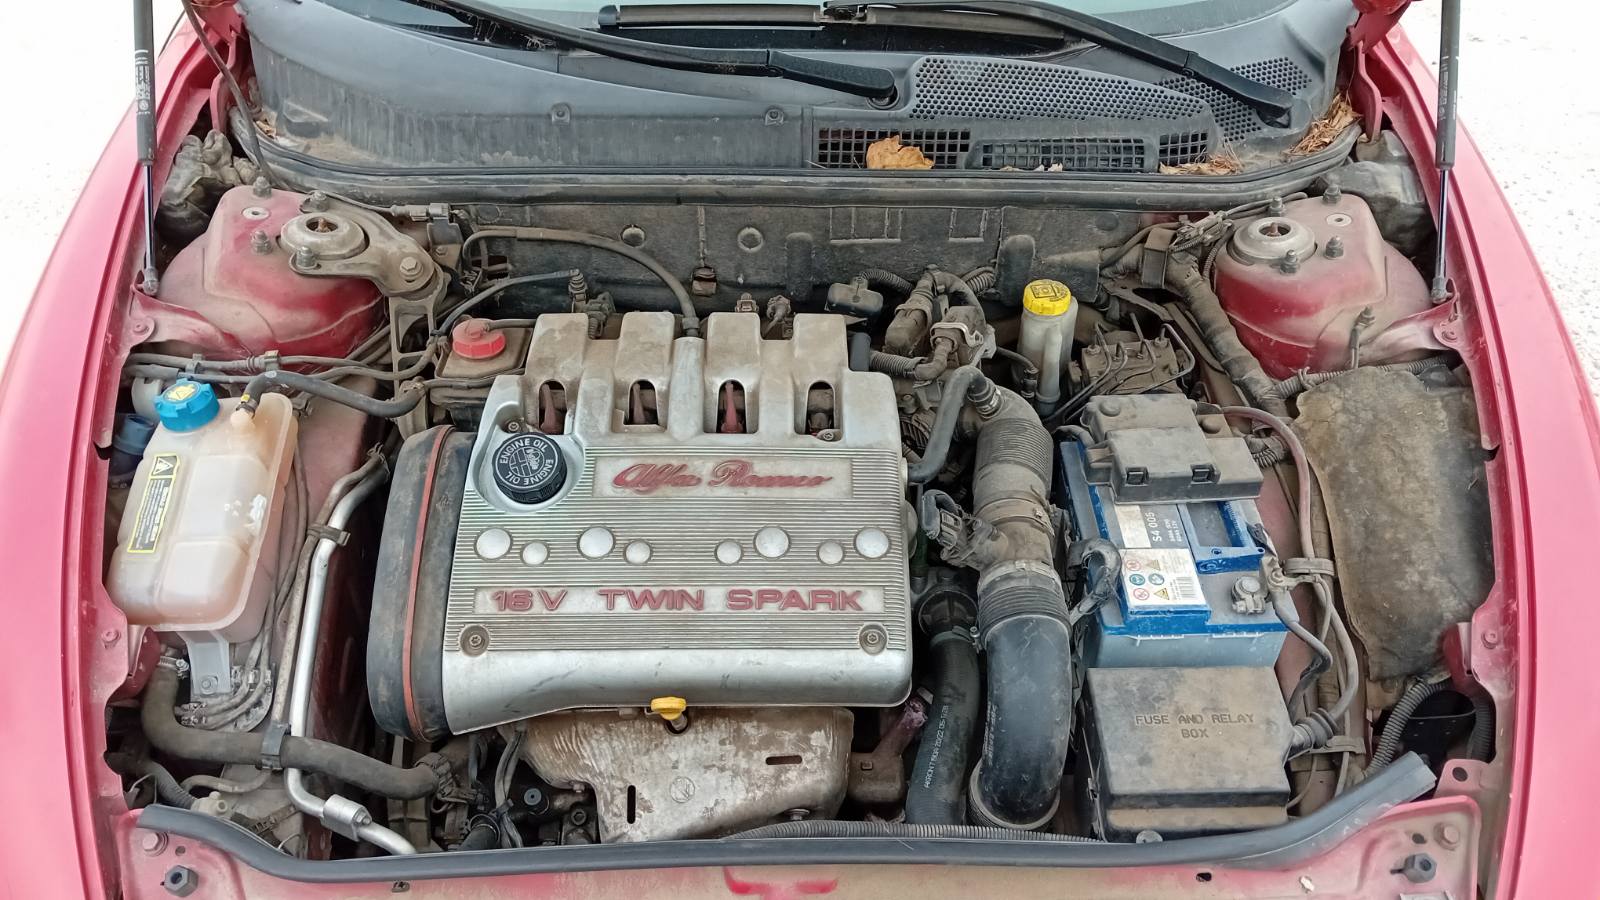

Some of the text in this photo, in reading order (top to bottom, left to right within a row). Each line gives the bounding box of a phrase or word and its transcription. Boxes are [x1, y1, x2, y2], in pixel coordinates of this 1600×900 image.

[500, 438, 548, 464] ENGINE OIL
[505, 459, 554, 485] ENGINE OIL
[612, 460, 833, 495] Alfa Romeo
[1145, 512, 1162, 542] S4 005
[599, 590, 704, 611] TWIN
[727, 590, 863, 611] SPARK
[1135, 713, 1254, 725] FUSE AND RELAY
[1181, 728, 1208, 738] BOX
